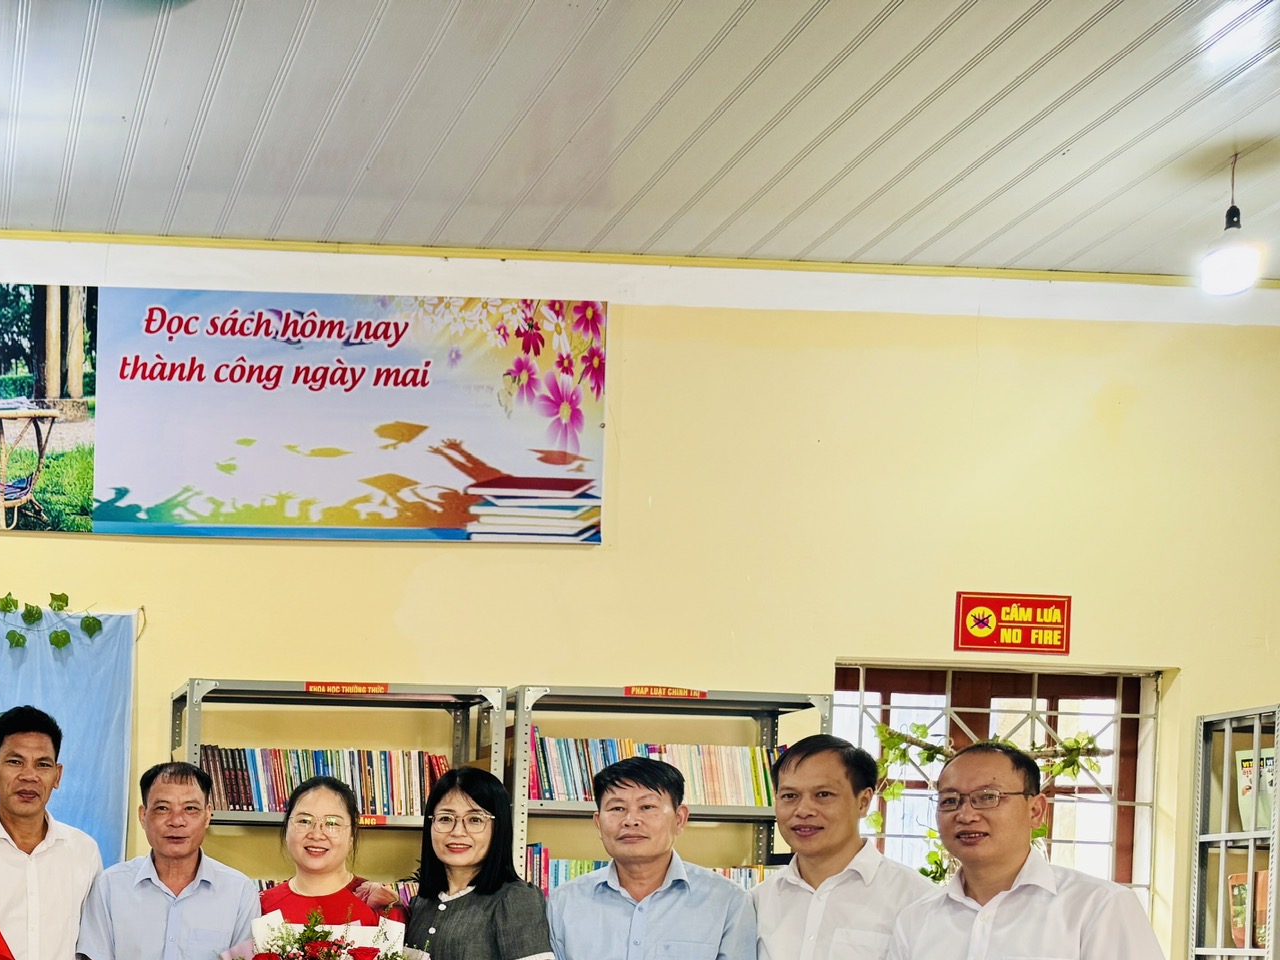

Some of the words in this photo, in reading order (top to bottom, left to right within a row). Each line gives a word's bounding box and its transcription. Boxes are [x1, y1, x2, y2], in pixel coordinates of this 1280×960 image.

[144, 306, 199, 341] Đọc
[206, 308, 272, 338] sách
[280, 310, 346, 340] hôm
[353, 320, 409, 348] nay
[119, 355, 205, 382] thành
[214, 356, 281, 389] công
[292, 358, 366, 392] ngày
[373, 360, 431, 387] mai
[1001, 603, 1032, 622] CẤM
[1000, 628, 1022, 643] NO
[1031, 629, 1061, 645] FIRE
